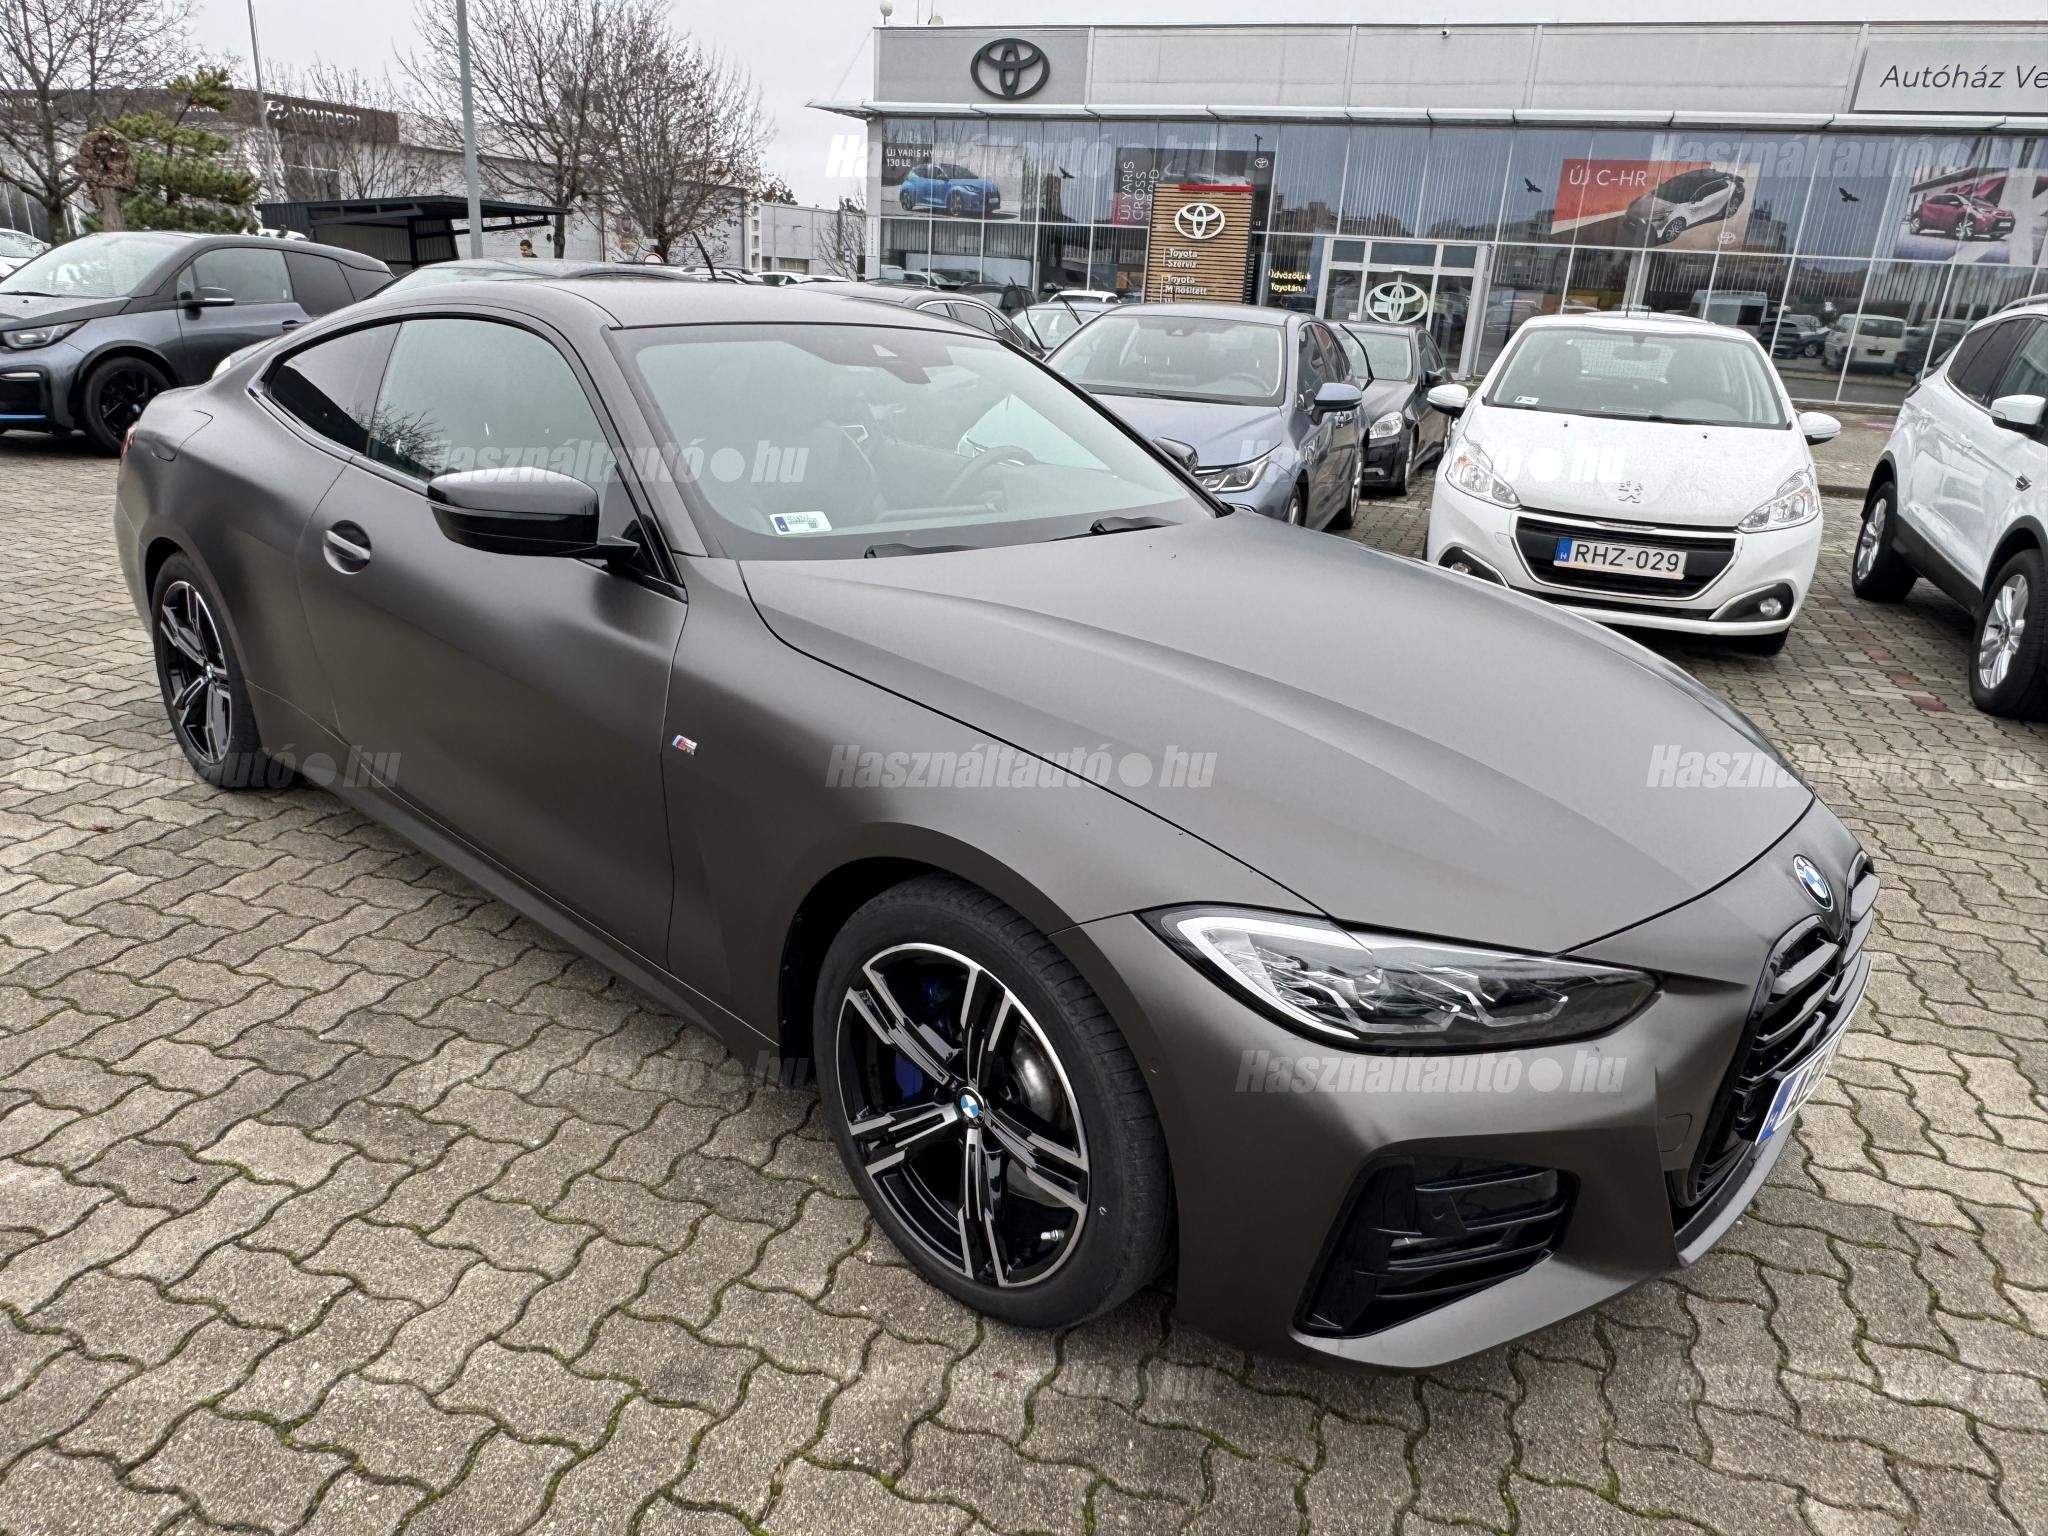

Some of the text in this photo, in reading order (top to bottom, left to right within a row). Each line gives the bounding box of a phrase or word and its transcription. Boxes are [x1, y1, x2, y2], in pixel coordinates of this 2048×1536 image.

[1879, 63, 2006, 89] Autóház
[1121, 161, 1135, 200] YARIS
[1568, 164, 1648, 187] ÚJ C-HR
[1132, 171, 1147, 221] CROSS
[1168, 247, 1199, 259] Toyota
[1166, 274, 1196, 285] Toyota
[1573, 543, 1680, 573] RHZ-029
